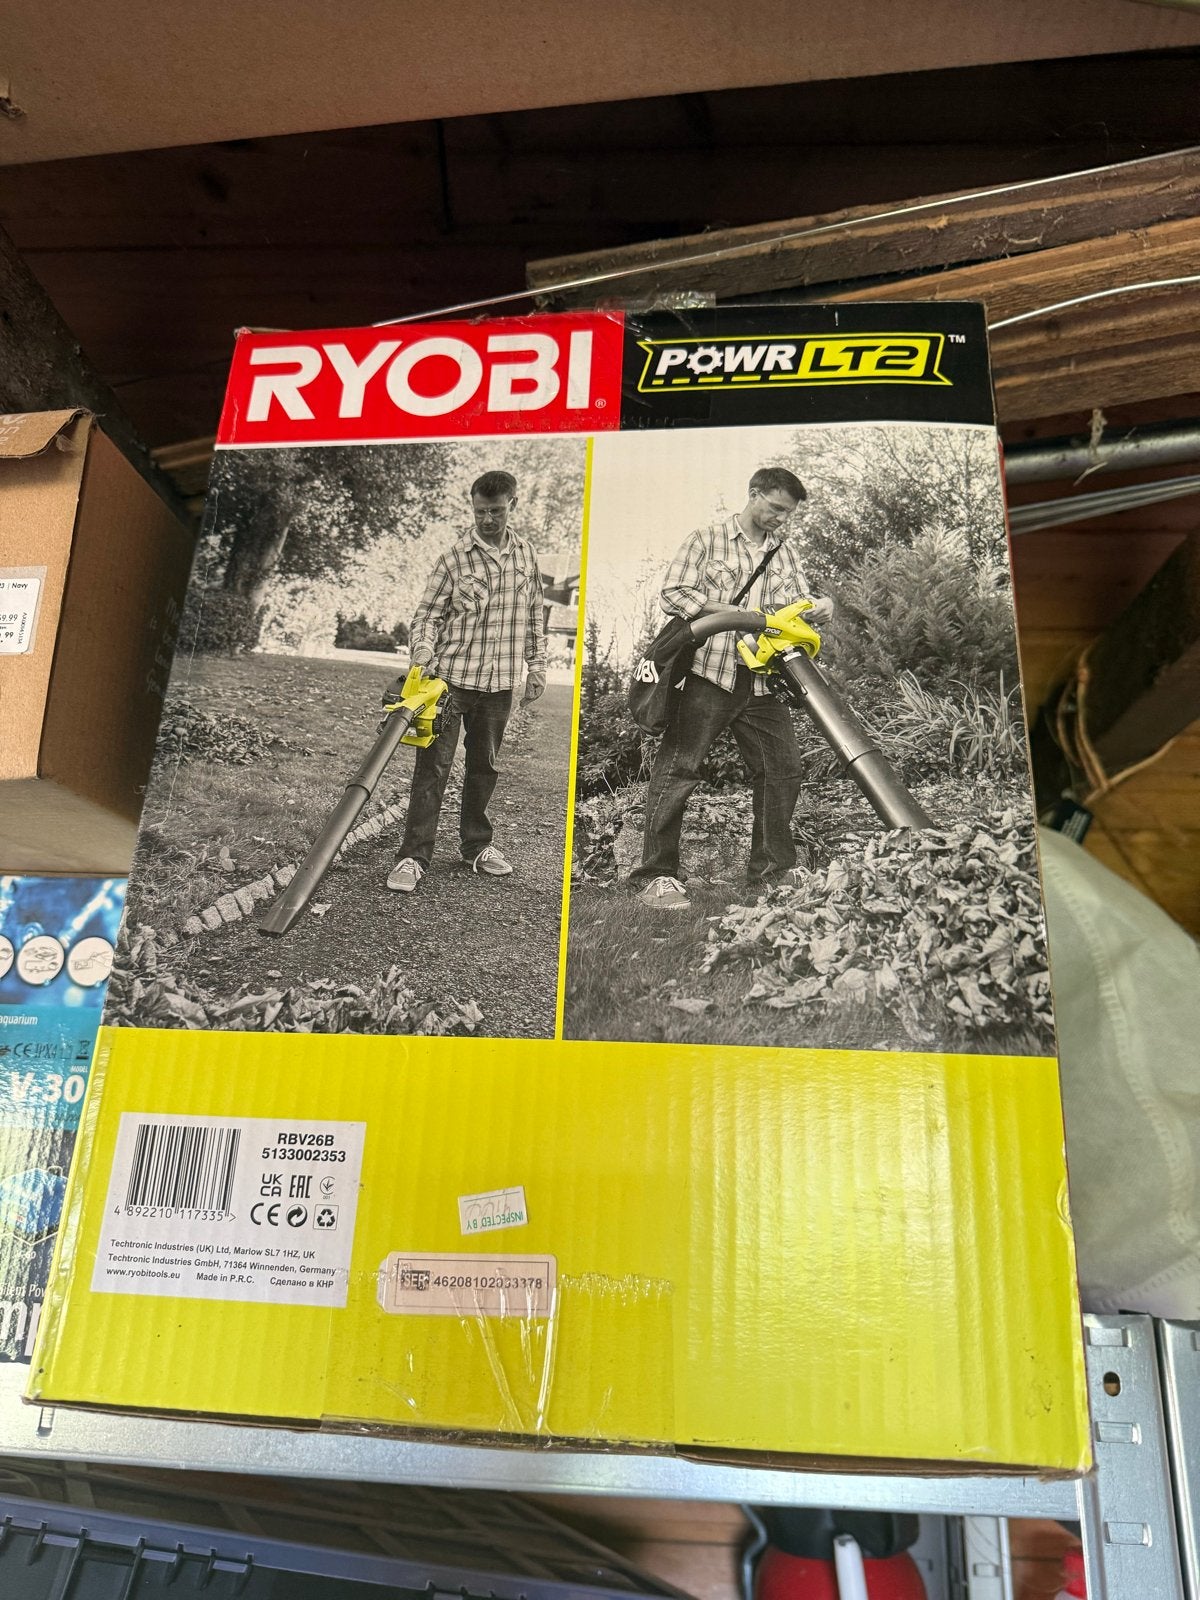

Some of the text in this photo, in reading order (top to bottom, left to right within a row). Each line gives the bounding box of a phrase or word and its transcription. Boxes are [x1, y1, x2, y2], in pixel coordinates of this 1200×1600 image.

[810, 345, 920, 371] LT2
[247, 330, 593, 422] RYOBI
[12, 582, 28, 590] Navy
[277, 1132, 335, 1147] RBV26B
[261, 1147, 347, 1163] 5133002353
[261, 1173, 283, 1185] UK
[114, 1204, 224, 1222] 4 892210 117335
[466, 1210, 524, 1230] INSPECTED BY
[110, 1239, 316, 1259] Techtronic Industries (UK) Ltd, Marlow SL7 1HZ, UK
[108, 1253, 337, 1276] Techtronic Industries GmbH, 71364 Winnenden, Germany
[106, 1268, 255, 1284] www.ryobitools.eu Made in P.R.C.
[270, 1276, 335, 1288] Сделано в КНР
